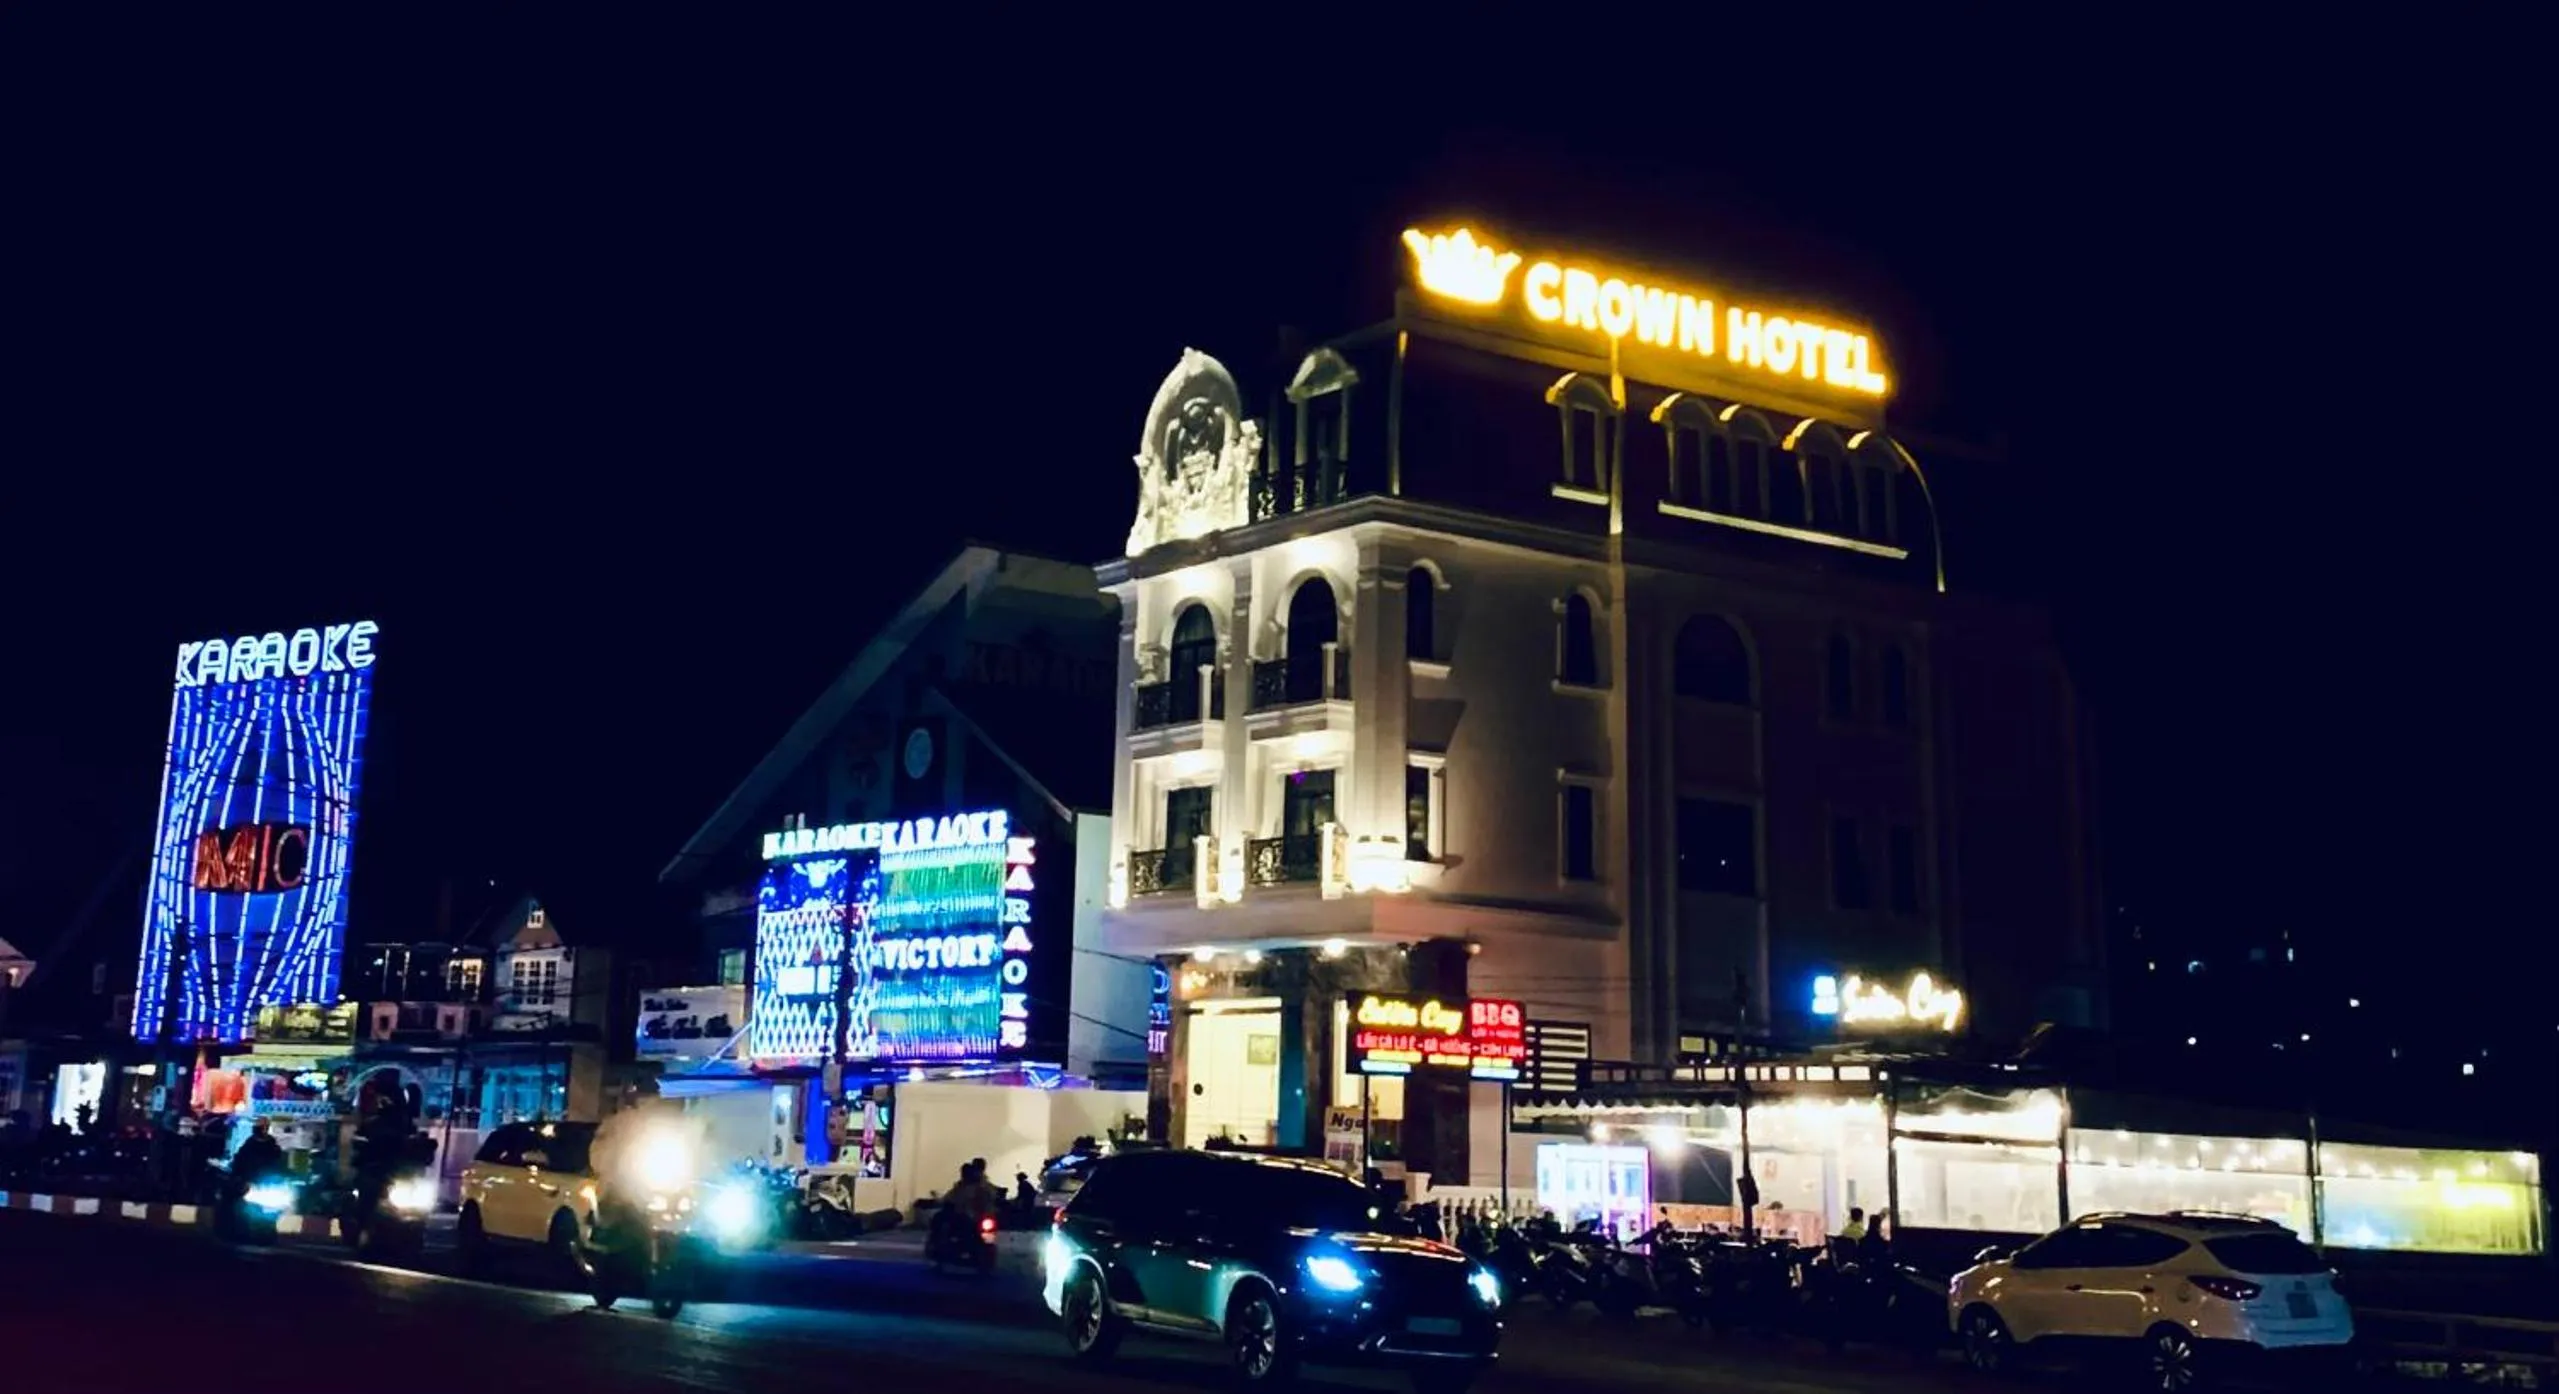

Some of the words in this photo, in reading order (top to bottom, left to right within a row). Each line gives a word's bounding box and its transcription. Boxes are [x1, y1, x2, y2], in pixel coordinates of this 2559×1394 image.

[1523, 260, 1716, 356] CROWN
[1725, 305, 1888, 395] HOTEL
[175, 620, 380, 688] KARAOKE
[194, 823, 307, 893] MIC
[762, 821, 881, 860] KARAOKE
[880, 809, 1008, 855] KARAOKE
[879, 933, 997, 971] VICTORY
[1001, 836, 1037, 1049] KARAOKE
[1471, 1002, 1520, 1026] BBQ
